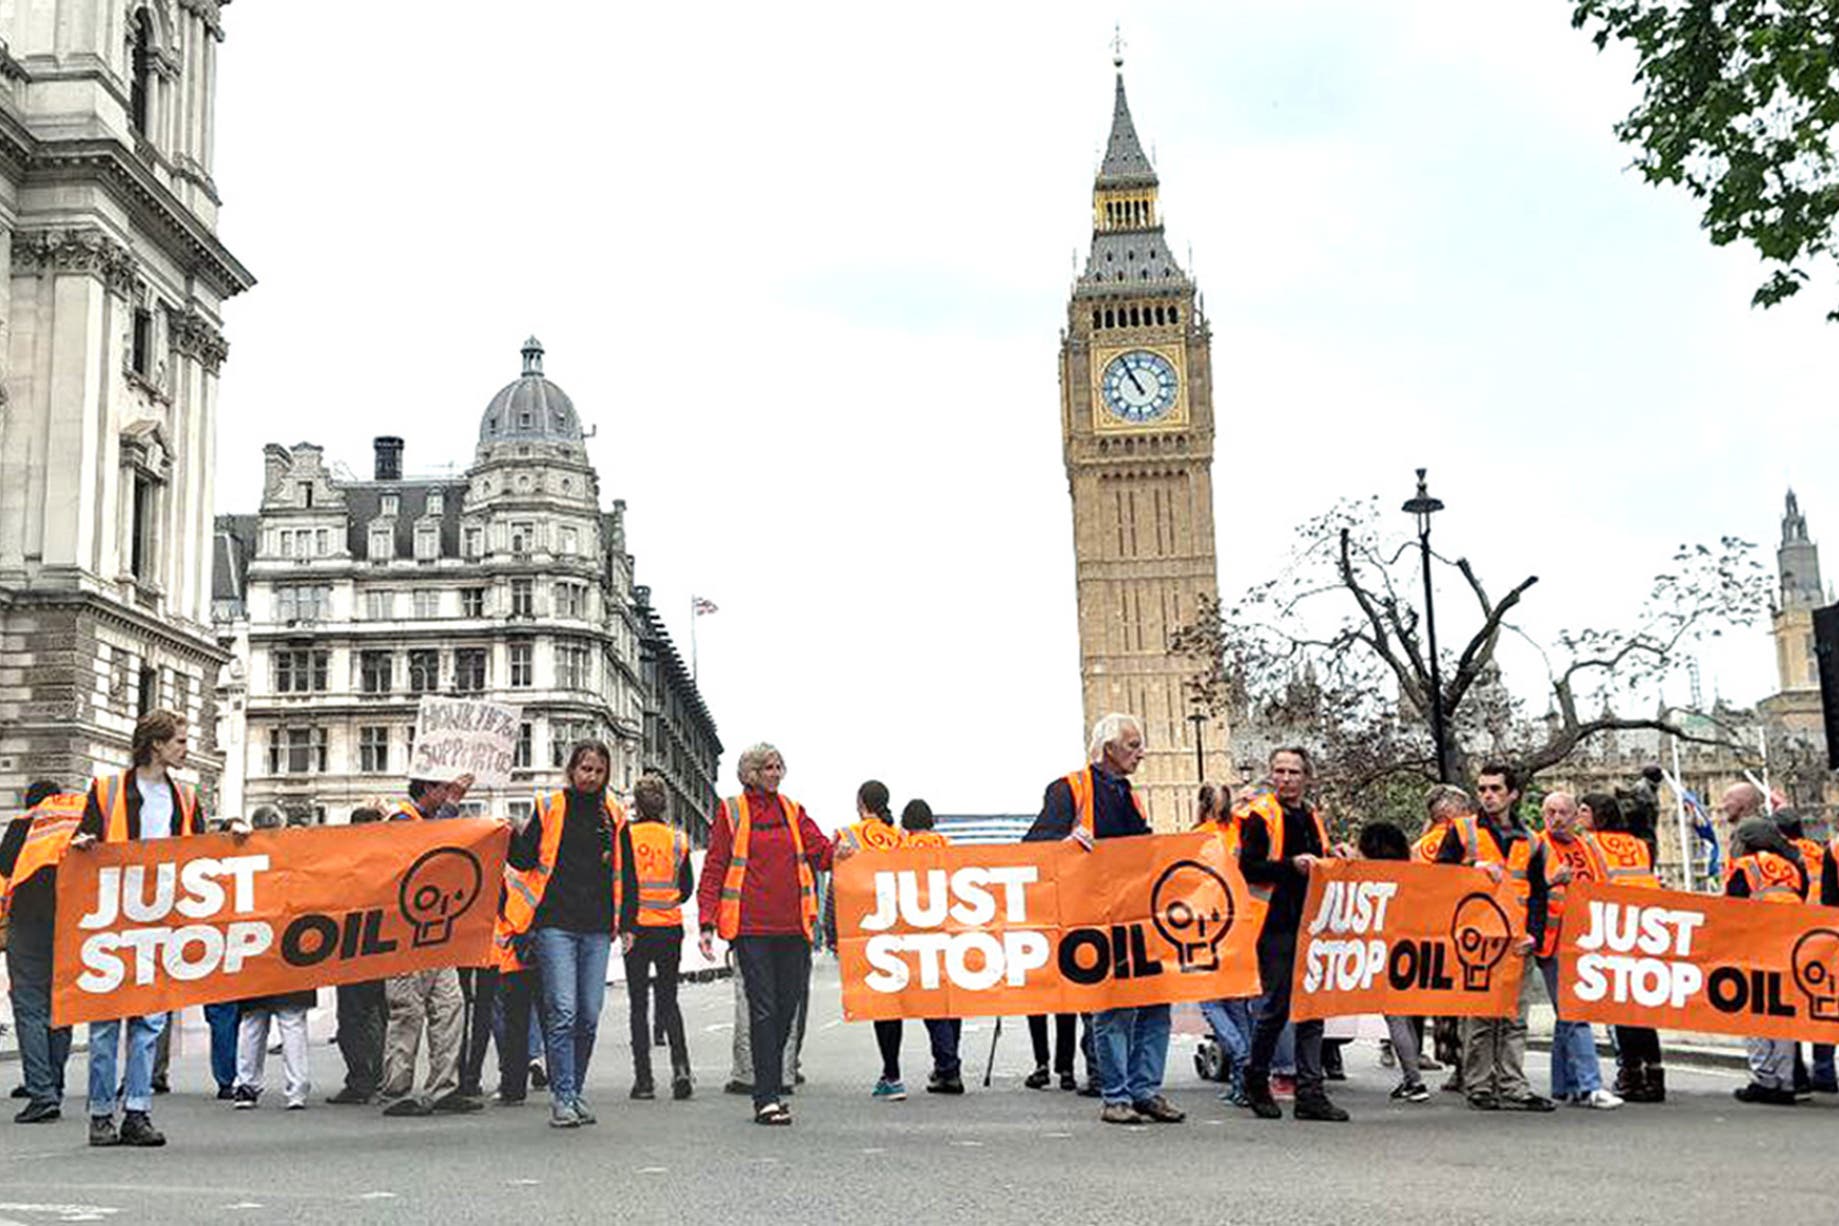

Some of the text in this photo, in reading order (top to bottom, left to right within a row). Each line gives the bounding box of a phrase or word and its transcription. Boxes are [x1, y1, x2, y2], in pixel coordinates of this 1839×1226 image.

[417, 738, 515, 775] SUPPORT US
[78, 854, 271, 930] JUST
[861, 866, 1038, 930] JUST
[1308, 880, 1398, 935] JUST
[76, 909, 398, 993] STOP OIL
[864, 923, 1163, 993] STOP OIL
[1575, 900, 1705, 957] JUST
[1303, 938, 1453, 994] STOP OIL
[1573, 954, 1796, 1018] STOP OIL
